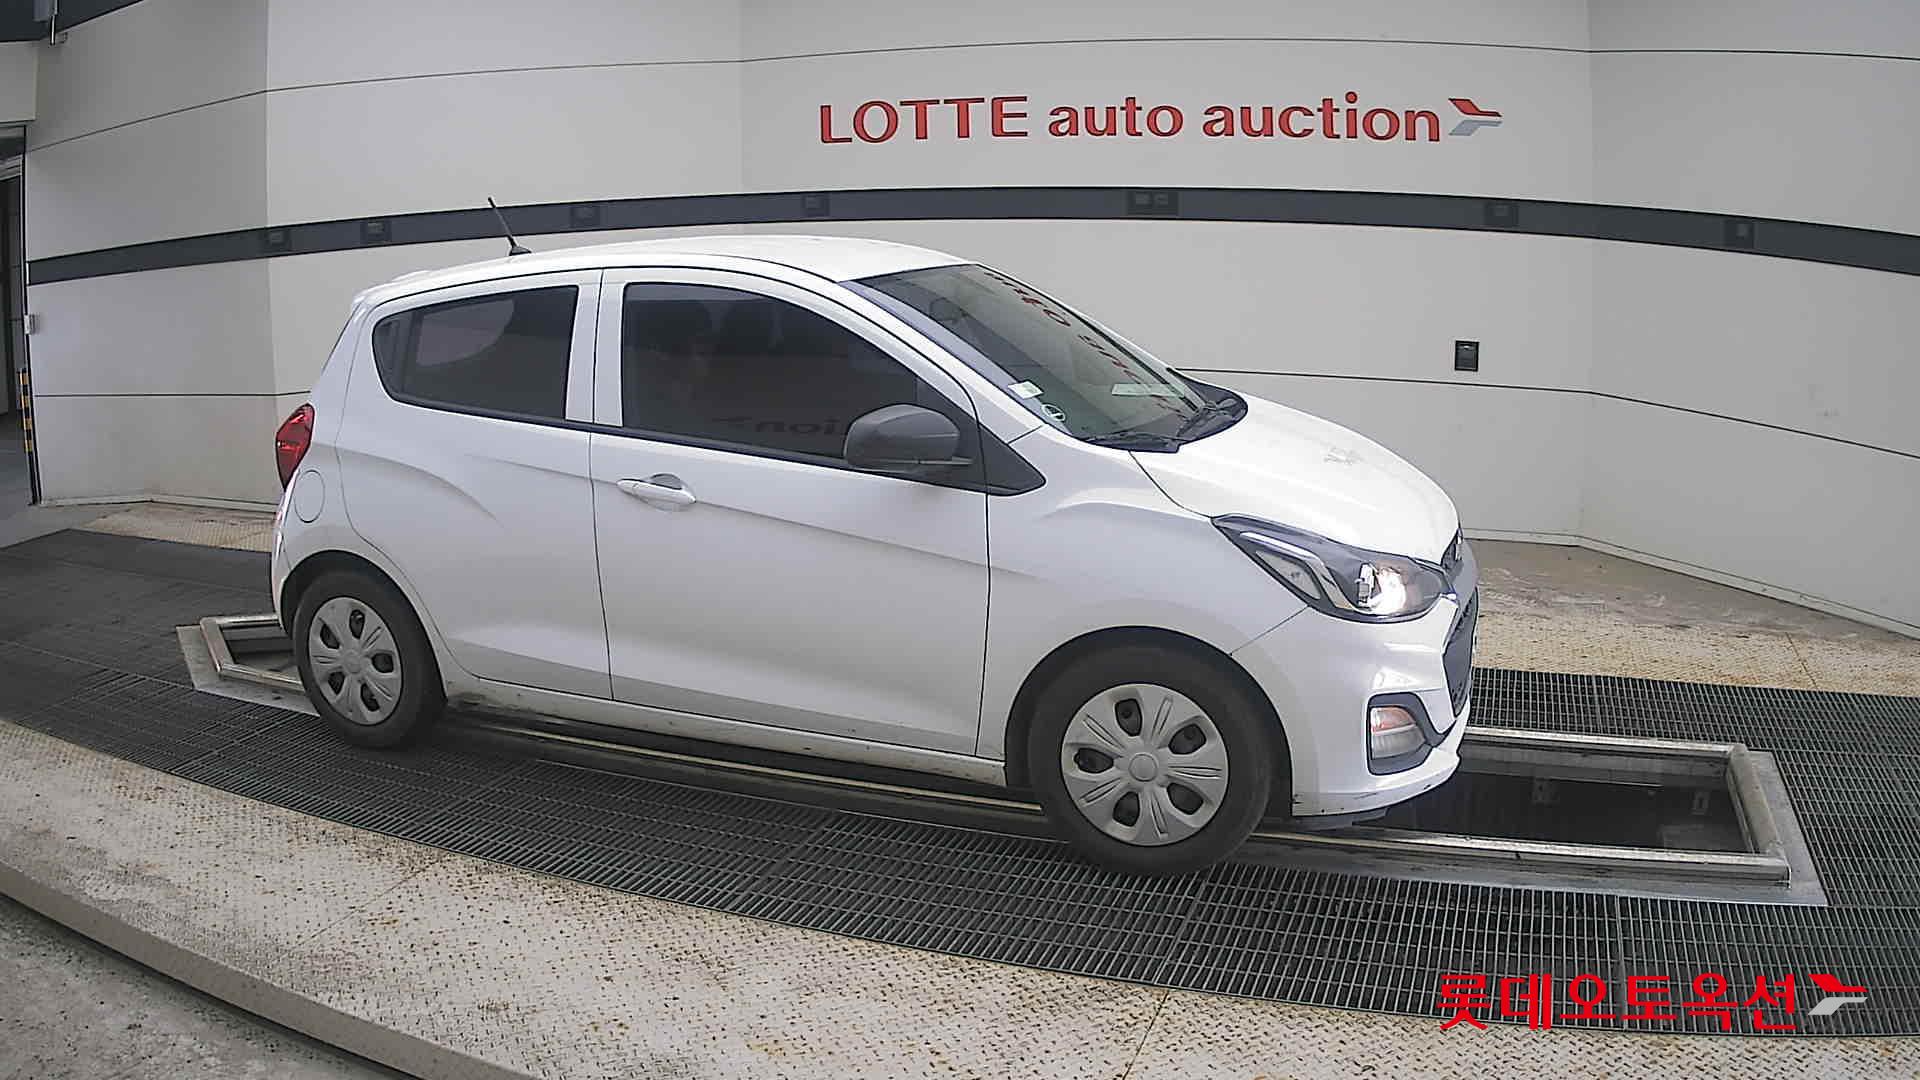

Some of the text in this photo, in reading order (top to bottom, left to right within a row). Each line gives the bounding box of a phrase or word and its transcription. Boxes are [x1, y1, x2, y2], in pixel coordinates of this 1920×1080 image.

[820, 91, 1440, 143] LOTTE auto auction
